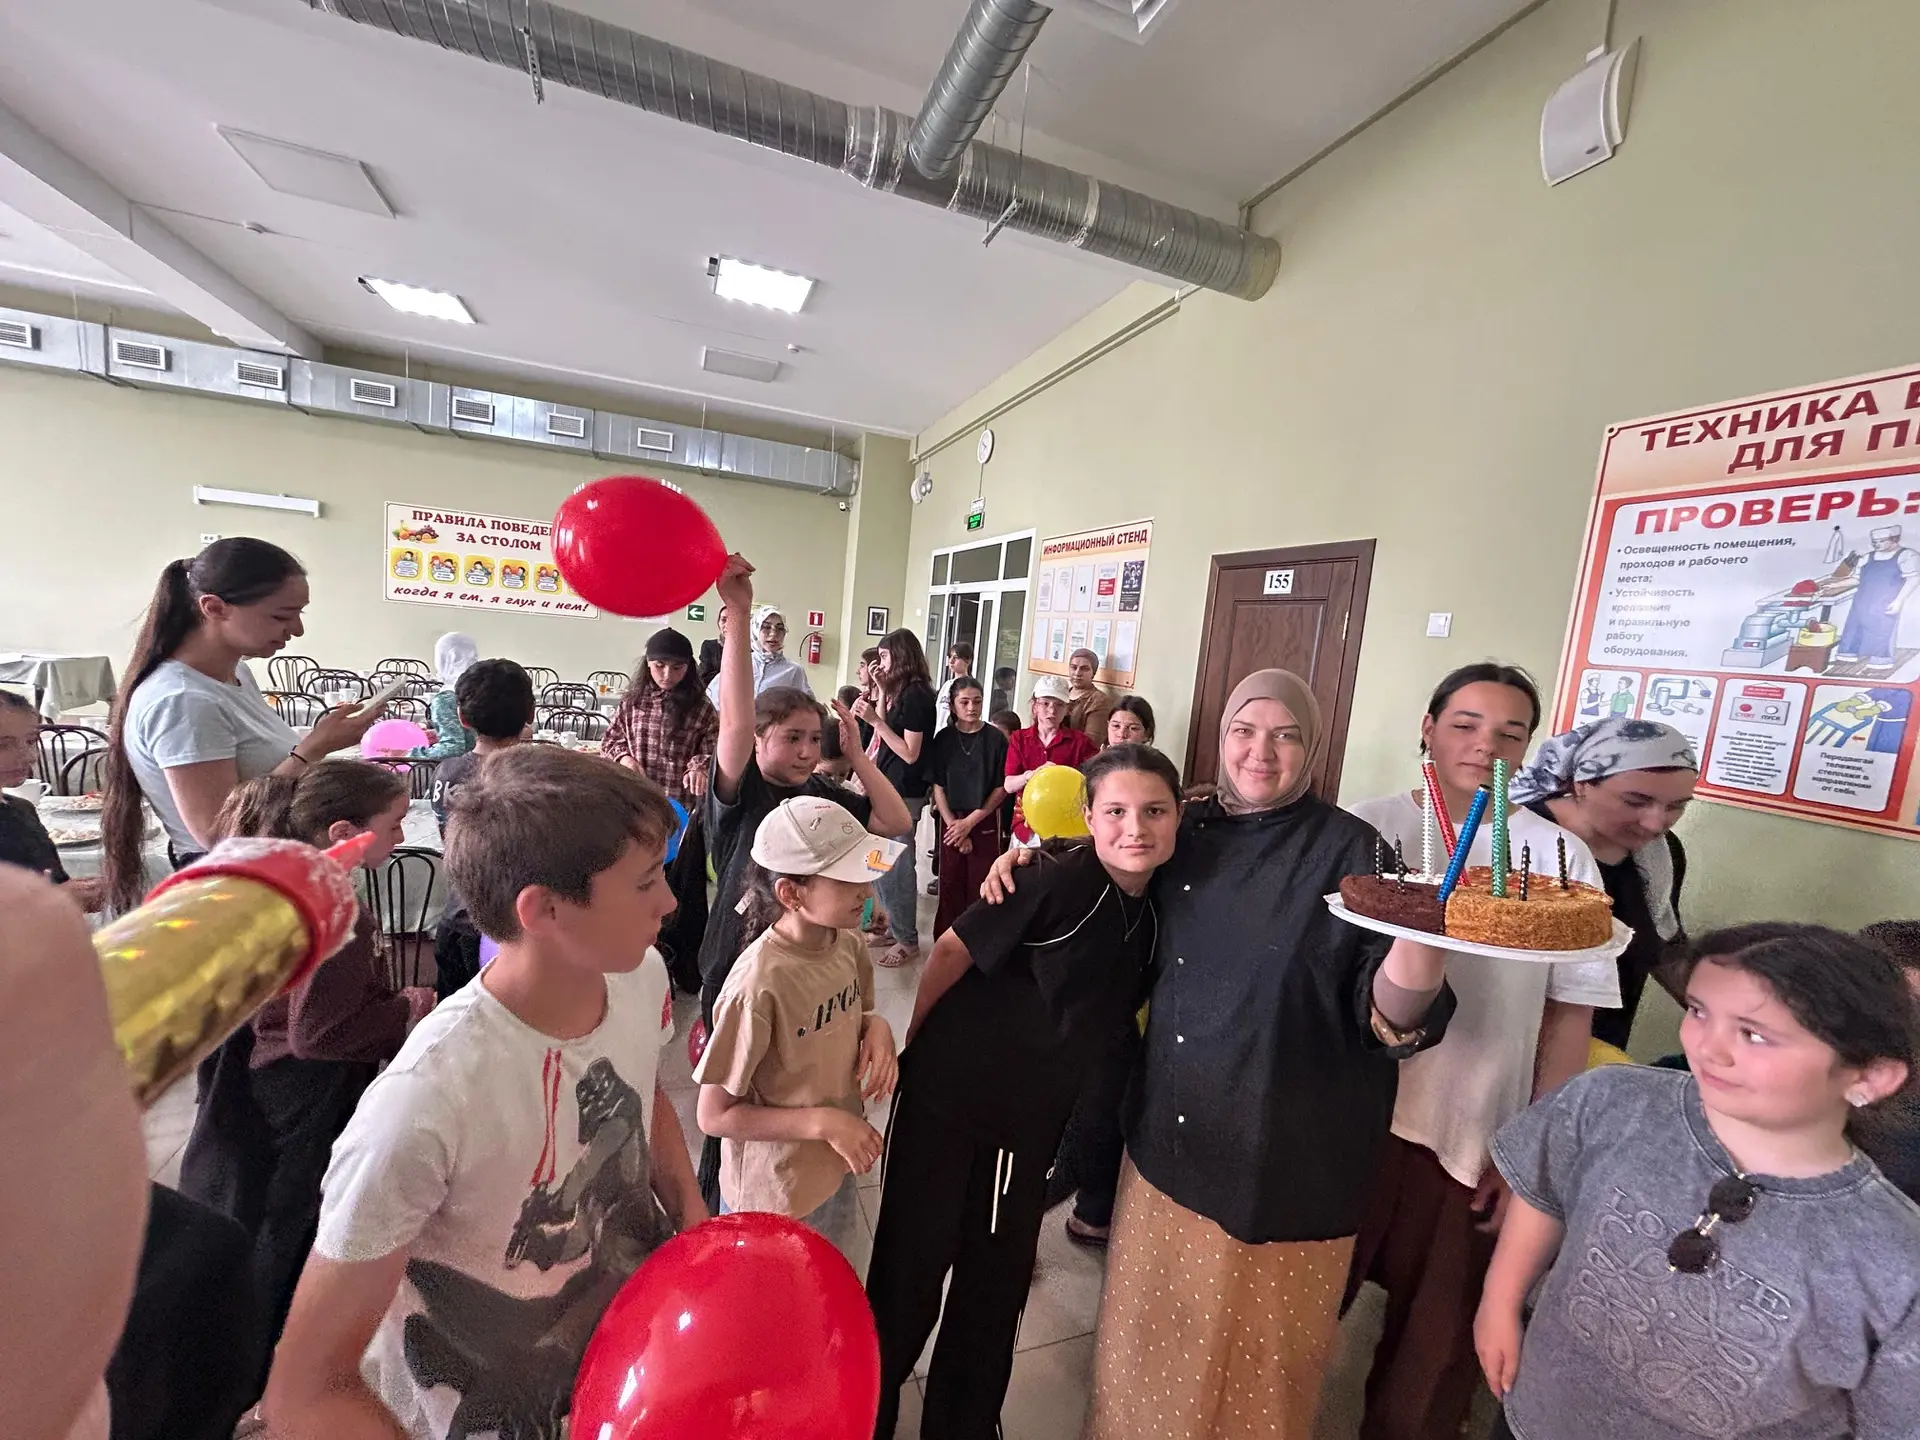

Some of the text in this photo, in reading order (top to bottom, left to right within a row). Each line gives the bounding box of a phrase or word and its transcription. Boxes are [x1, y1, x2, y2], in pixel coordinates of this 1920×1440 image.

[1640, 390, 1879, 451] ТЕХНИКА
[1727, 419, 1920, 474] ДЛЯ П
[1634, 488, 1920, 535] ПРОВЕРЬ:
[412, 510, 554, 536] ПРАВИЛА ПОВЕДЕ
[456, 532, 541, 551] ЗА СТОЛОМ
[1043, 529, 1148, 555] ИНФОРМАЦИОННЫЙ СТЕНД
[1623, 537, 1796, 556] Освещенность помещения,
[1619, 556, 1749, 571] проходов и рабочего
[1268, 574, 1290, 589] 155
[1617, 575, 1653, 584] места;
[393, 585, 439, 599] когда
[443, 591, 454, 600] я
[489, 595, 500, 604] я
[505, 596, 536, 608] глух
[541, 599, 551, 608] и
[556, 602, 590, 613] нем!
[1609, 618, 1691, 630] и правильную
[1606, 631, 1645, 642] работу
[1603, 645, 1689, 658] оборудования.
[1604, 1186, 1792, 1321] LOWE
